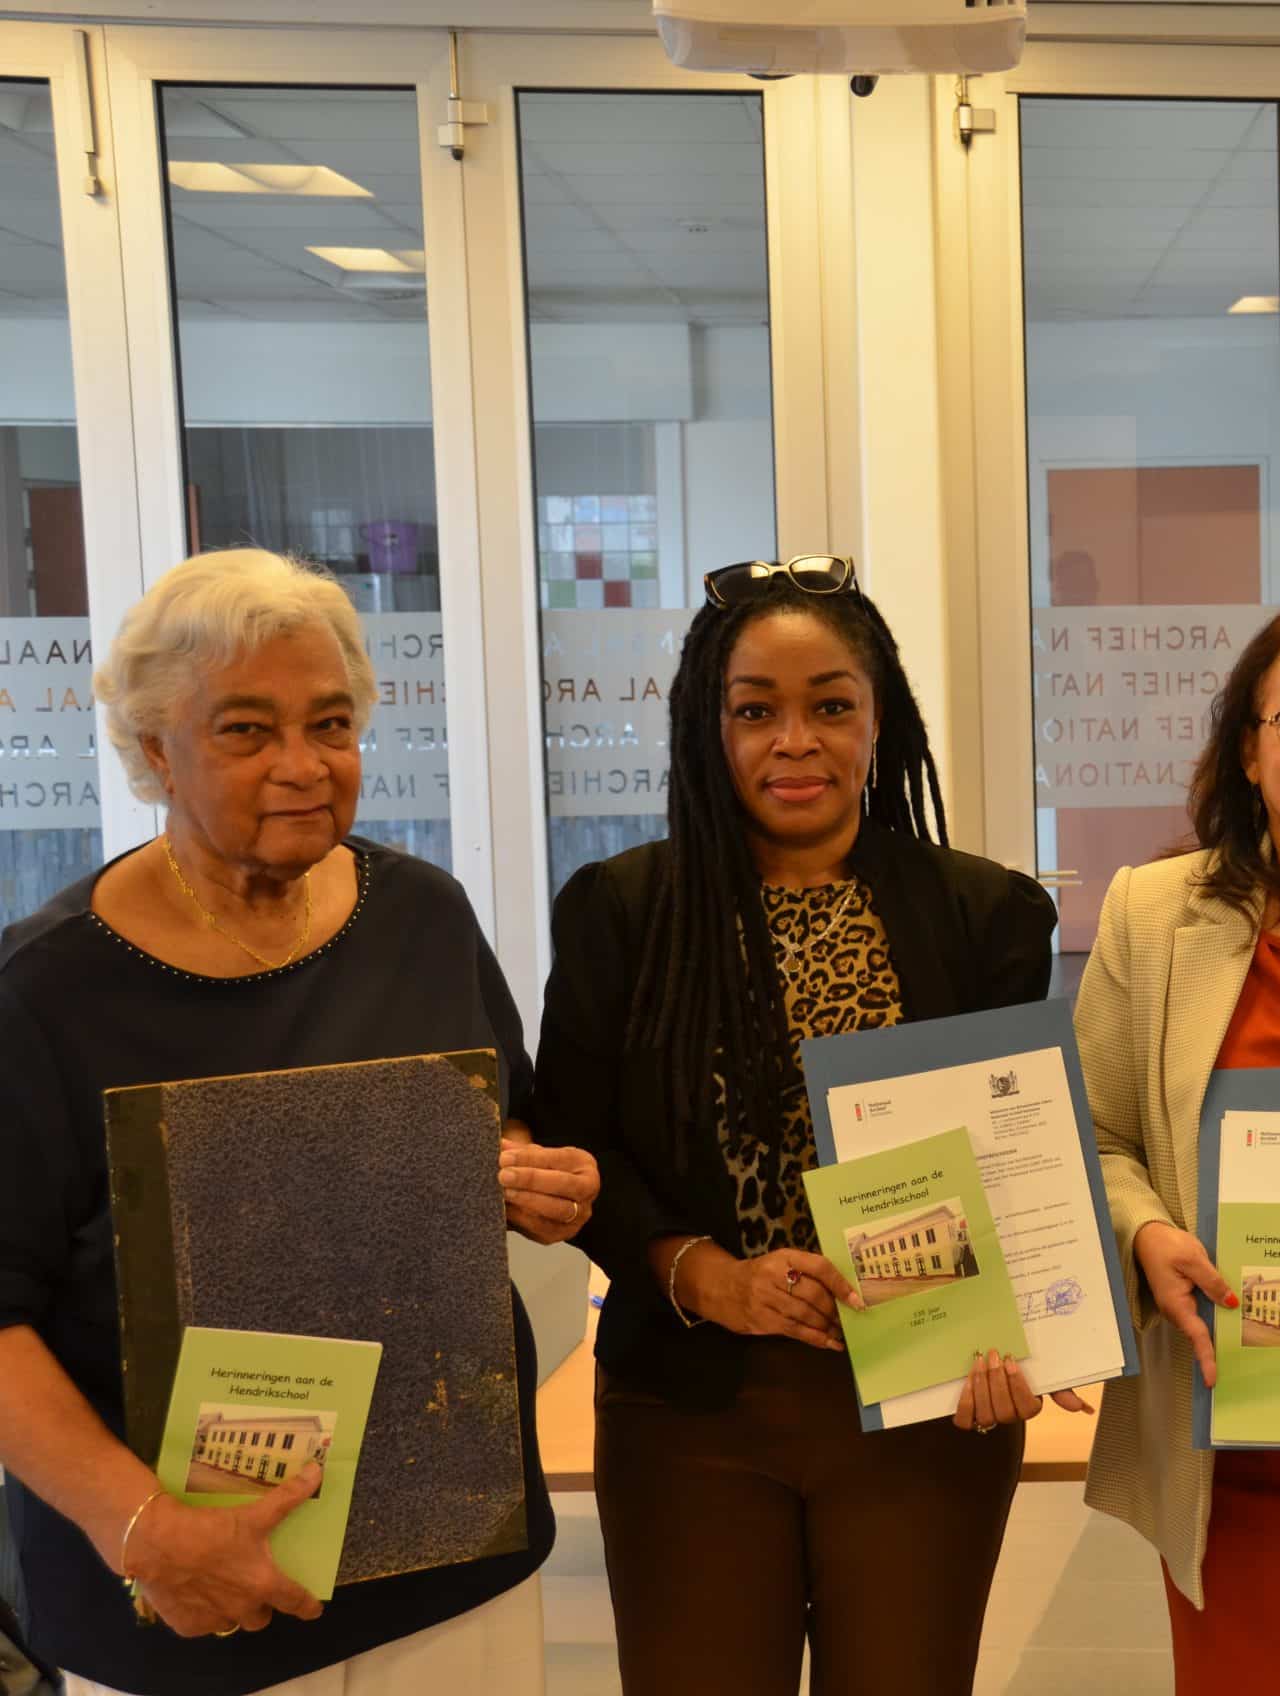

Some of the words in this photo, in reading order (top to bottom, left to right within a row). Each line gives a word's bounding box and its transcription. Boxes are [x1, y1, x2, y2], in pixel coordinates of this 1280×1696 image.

[838, 1181, 908, 1206] Herinneringen
[910, 1175, 929, 1187] aan
[931, 1168, 945, 1180] de
[861, 1188, 930, 1215] Hendrikschool
[210, 1367, 291, 1385] Herinneringen
[294, 1375, 316, 1385] aan
[319, 1375, 334, 1387] de
[228, 1384, 310, 1401] Hendrikschool
